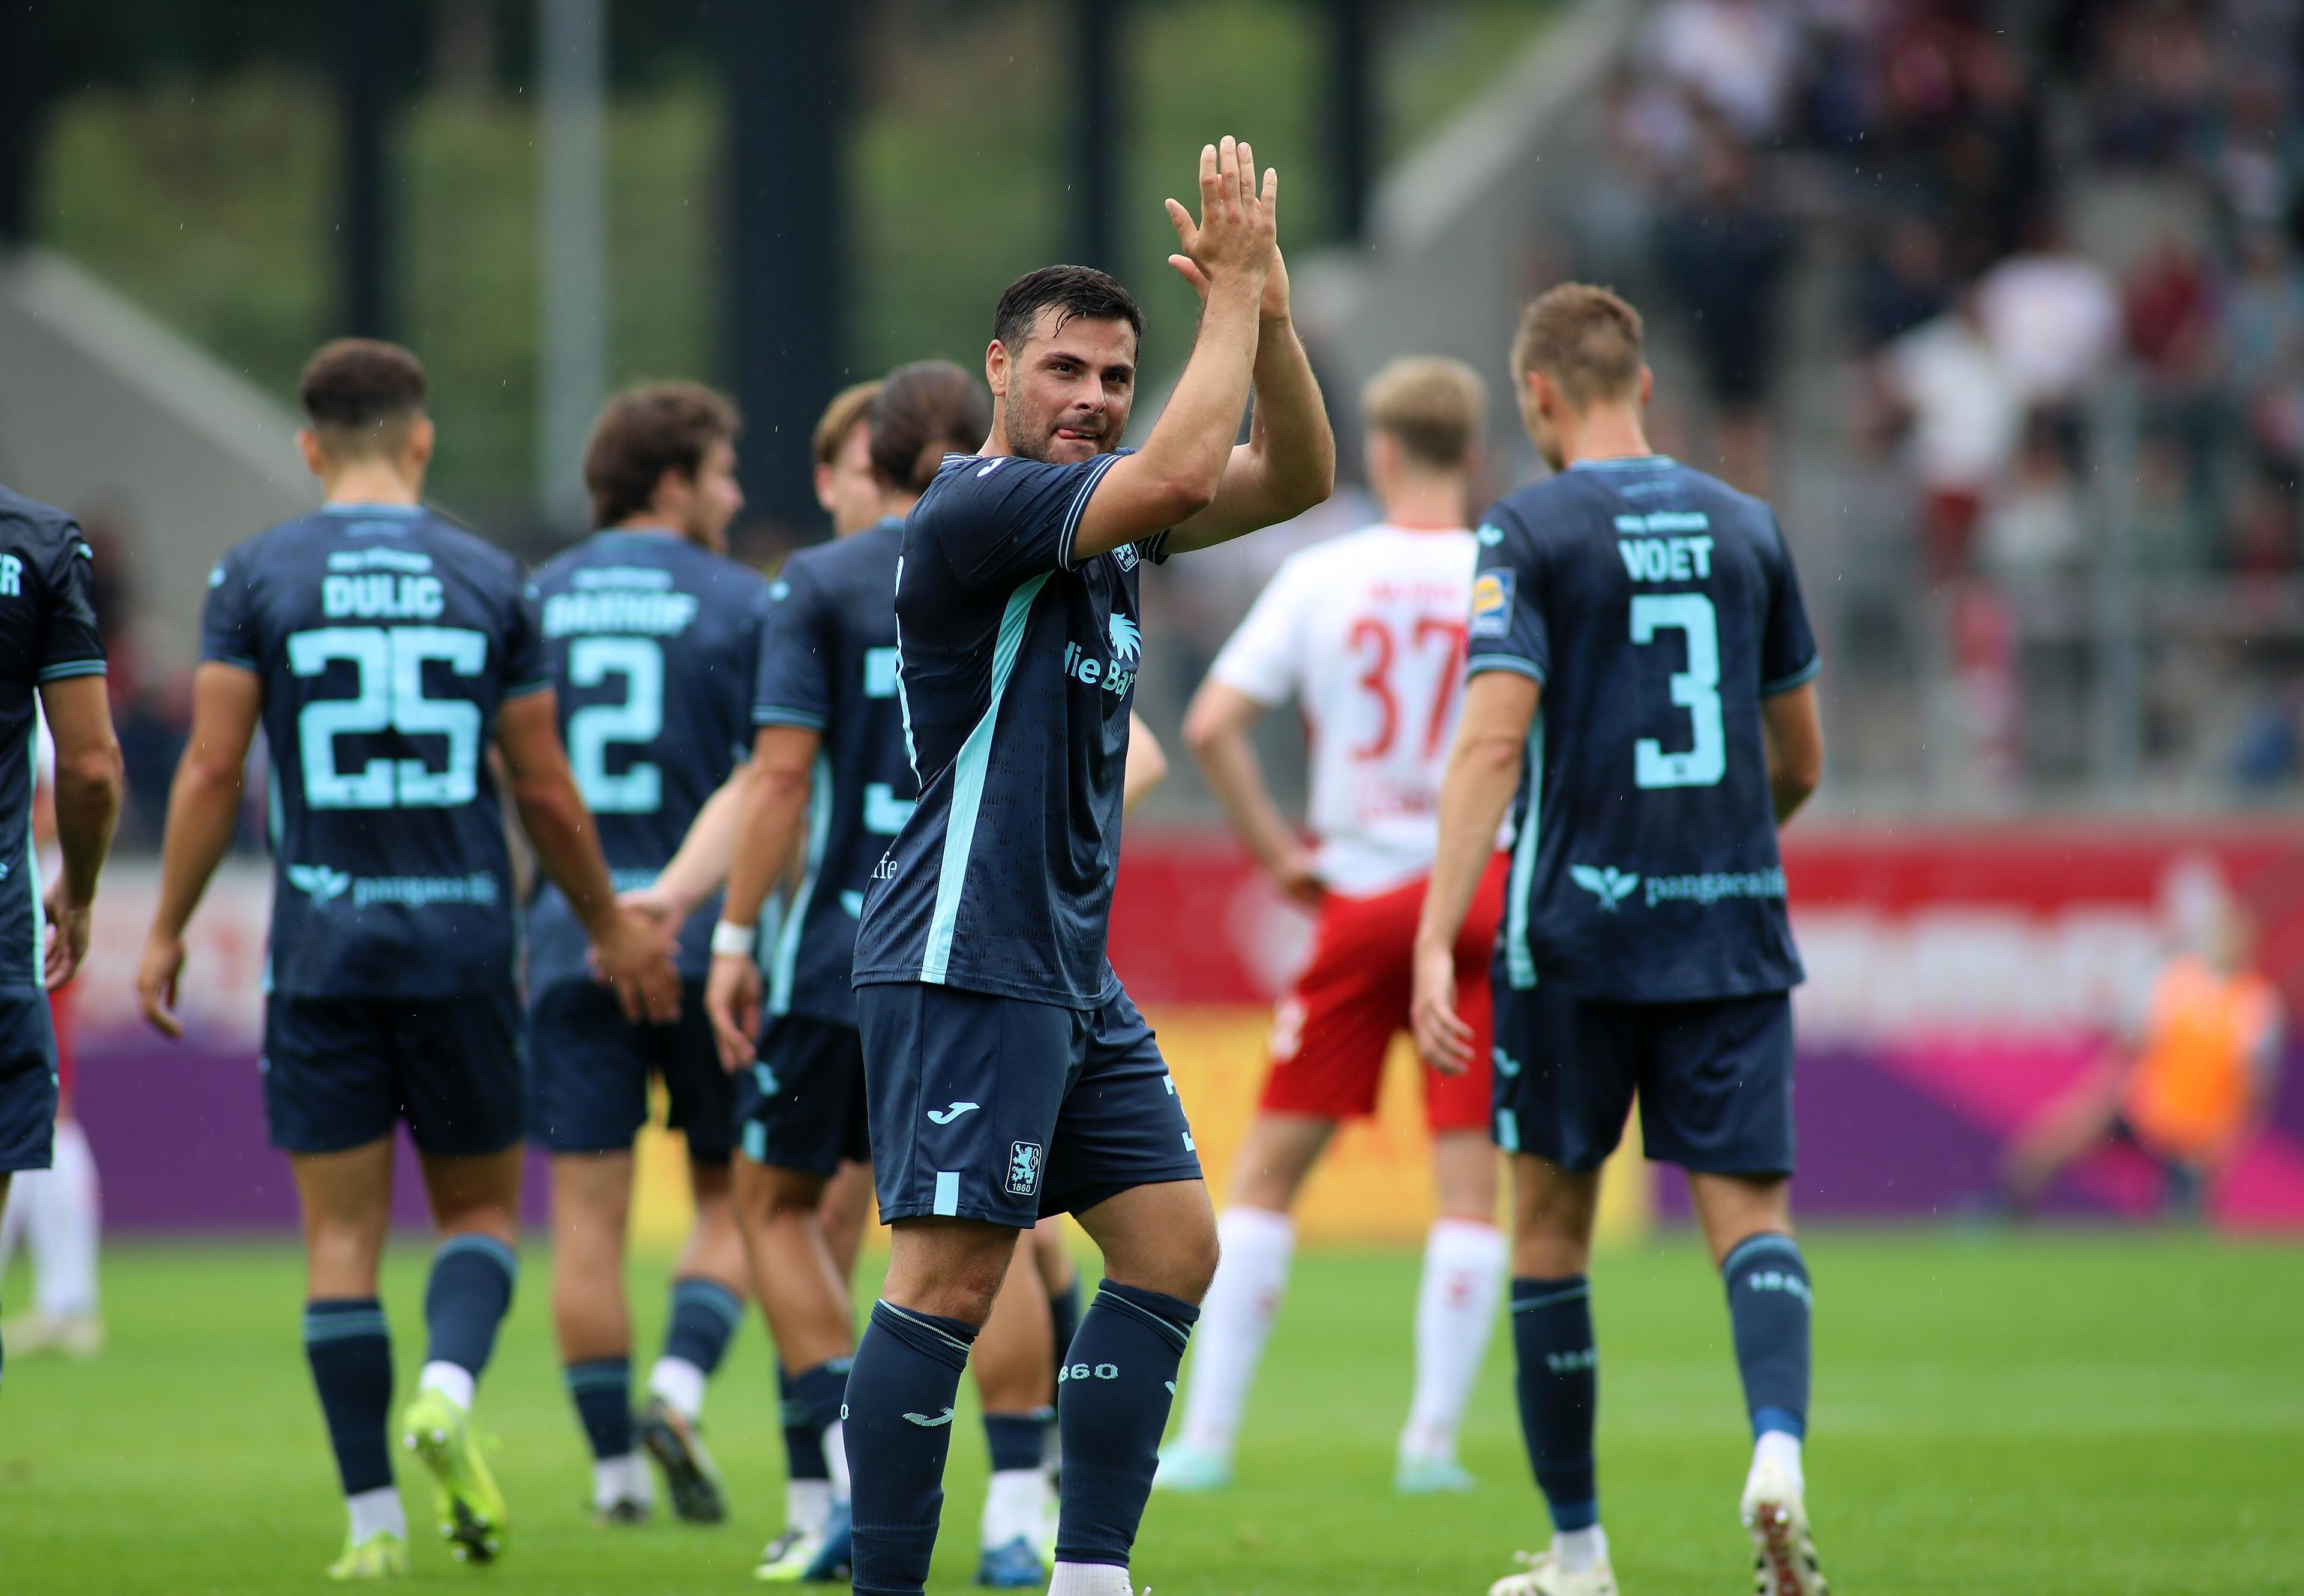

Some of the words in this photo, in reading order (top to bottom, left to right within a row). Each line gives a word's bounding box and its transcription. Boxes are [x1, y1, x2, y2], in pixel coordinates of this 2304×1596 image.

[0, 553, 22, 598] R
[1124, 554, 1135, 568] 1860
[1618, 535, 1715, 582] VOET
[322, 574, 444, 618] DULIC
[1348, 617, 1468, 760] 37
[1630, 593, 1726, 788] 3
[287, 626, 487, 808] 25
[568, 636, 662, 812] 2
[1013, 1183, 1030, 1192] 1860
